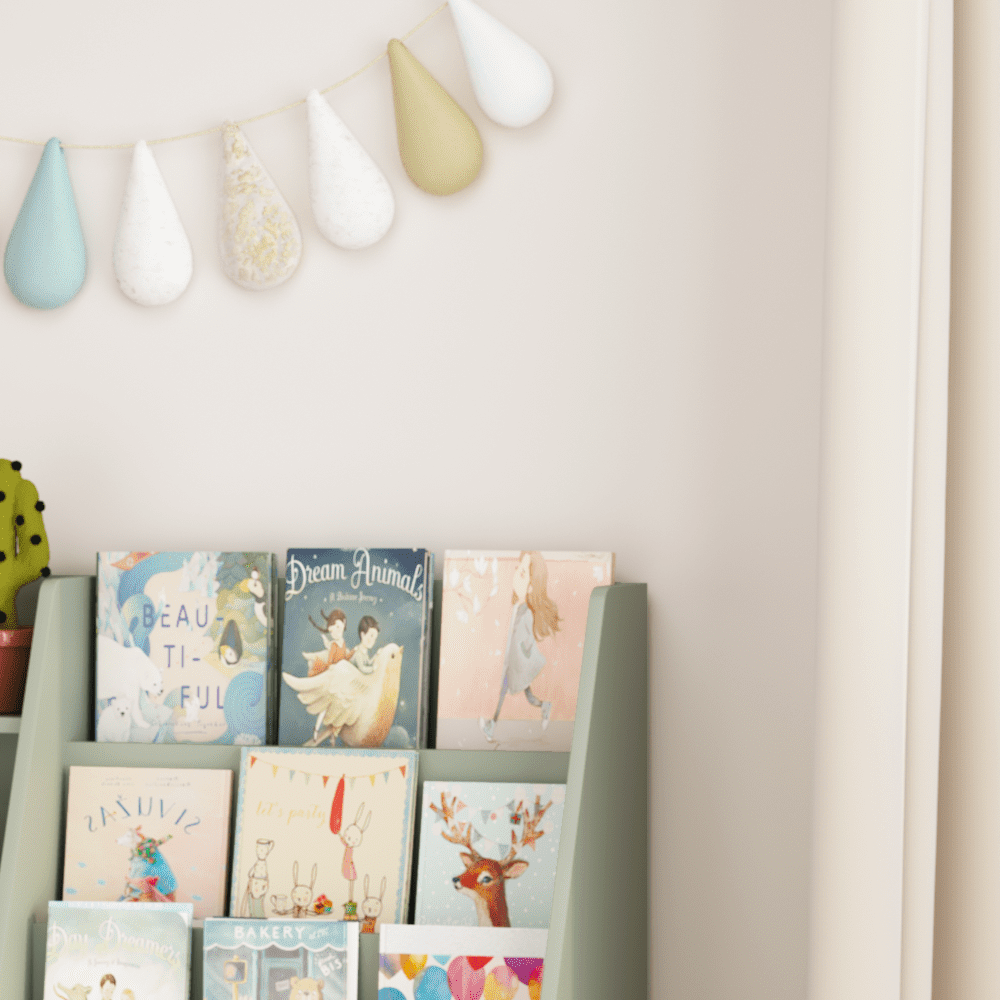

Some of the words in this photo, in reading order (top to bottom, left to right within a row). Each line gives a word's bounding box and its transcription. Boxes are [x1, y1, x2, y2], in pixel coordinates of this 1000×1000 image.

[285, 554, 347, 601] Dream
[351, 547, 423, 601] Animals
[163, 645, 201, 668] TI-
[234, 926, 305, 940] BAKERY
